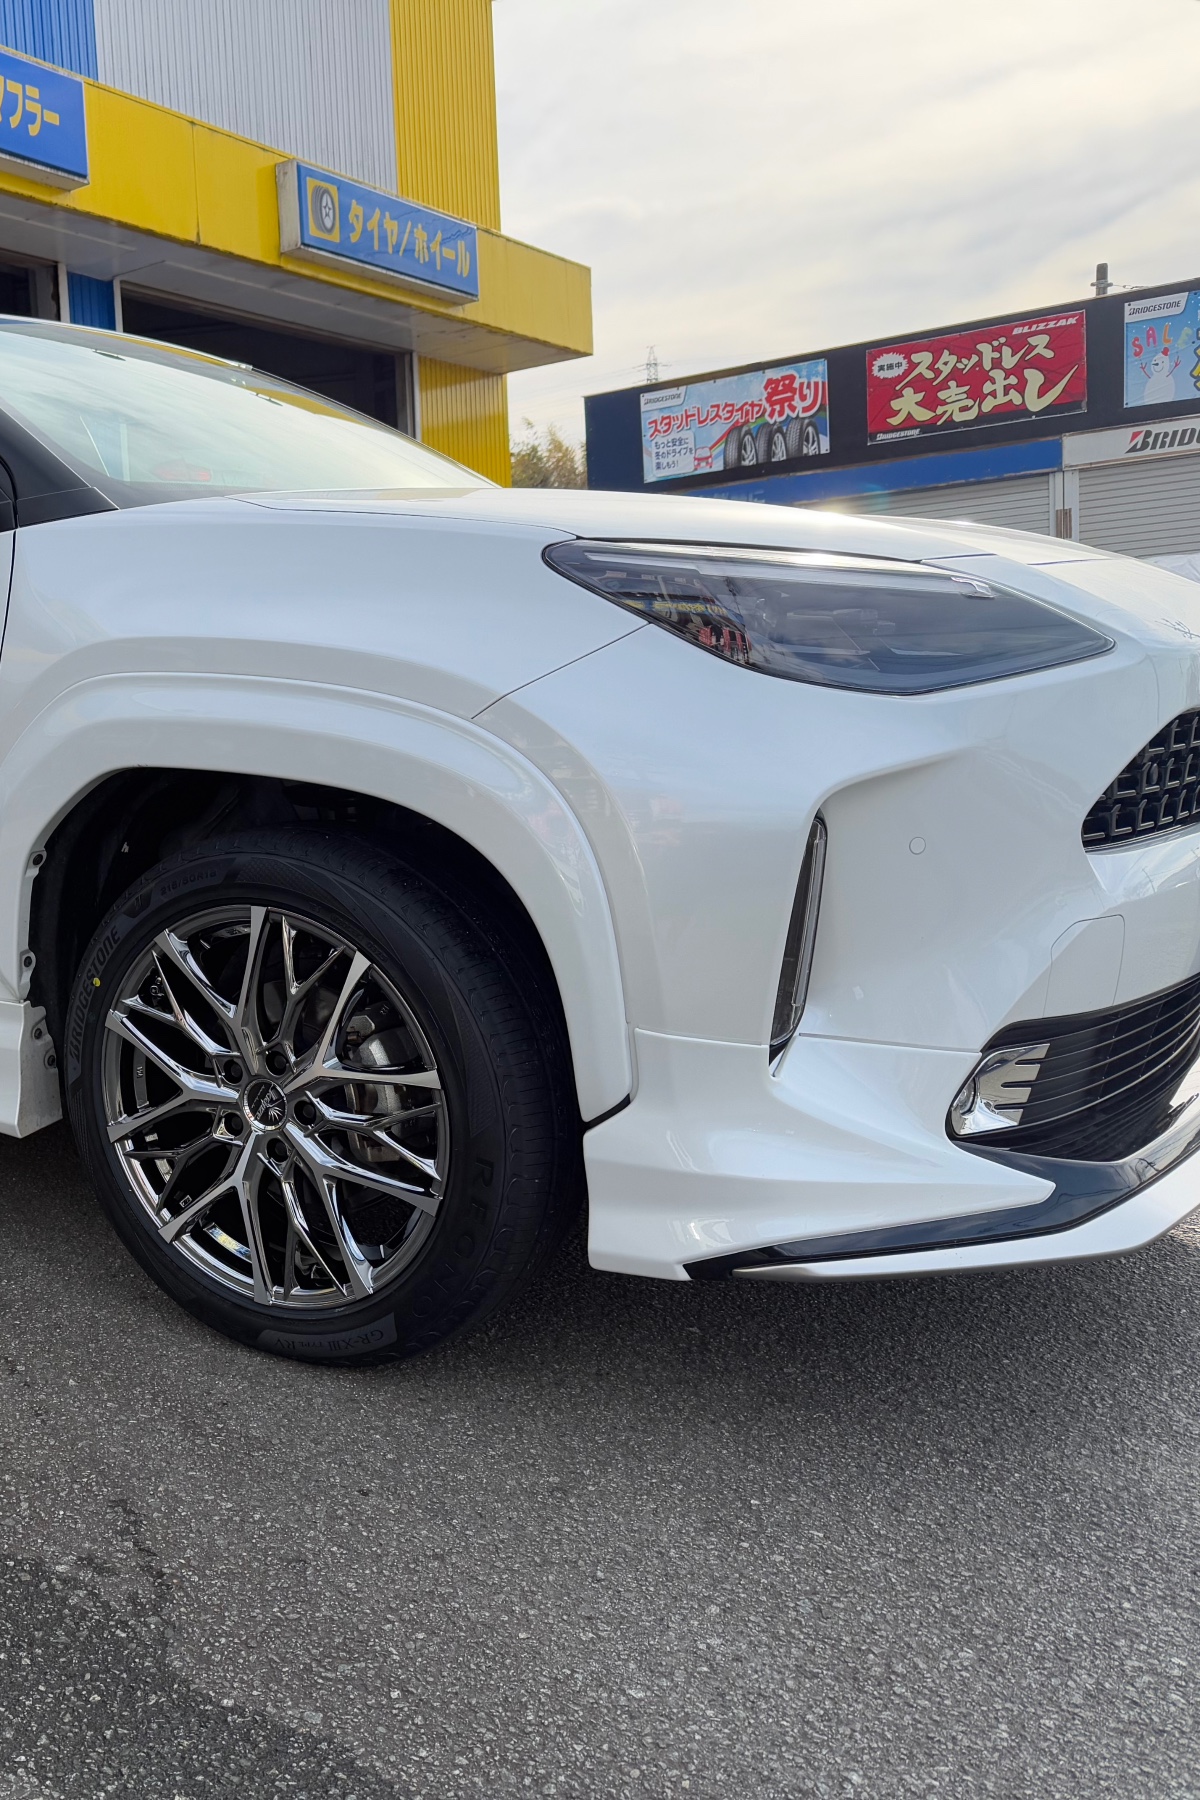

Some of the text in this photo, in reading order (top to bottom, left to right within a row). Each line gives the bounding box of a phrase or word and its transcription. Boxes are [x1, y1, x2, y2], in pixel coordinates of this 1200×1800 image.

[348, 199, 471, 278] タイヤ/ホイール
[1128, 300, 1181, 316] BRIDGESTONE
[1012, 316, 1079, 336] BLIZZAK
[1132, 324, 1193, 359] SALE
[877, 362, 903, 373] 実施中
[895, 334, 1055, 391] スタッドレス
[886, 364, 1079, 426] 大売出し
[876, 428, 920, 441] BRIDGESTONE
[1125, 428, 1200, 454] BRID
[654, 444, 694, 460] 冬のドライブを
[70, 925, 121, 1064] BRIDGESTONE
[275, 1338, 296, 1350] RV
